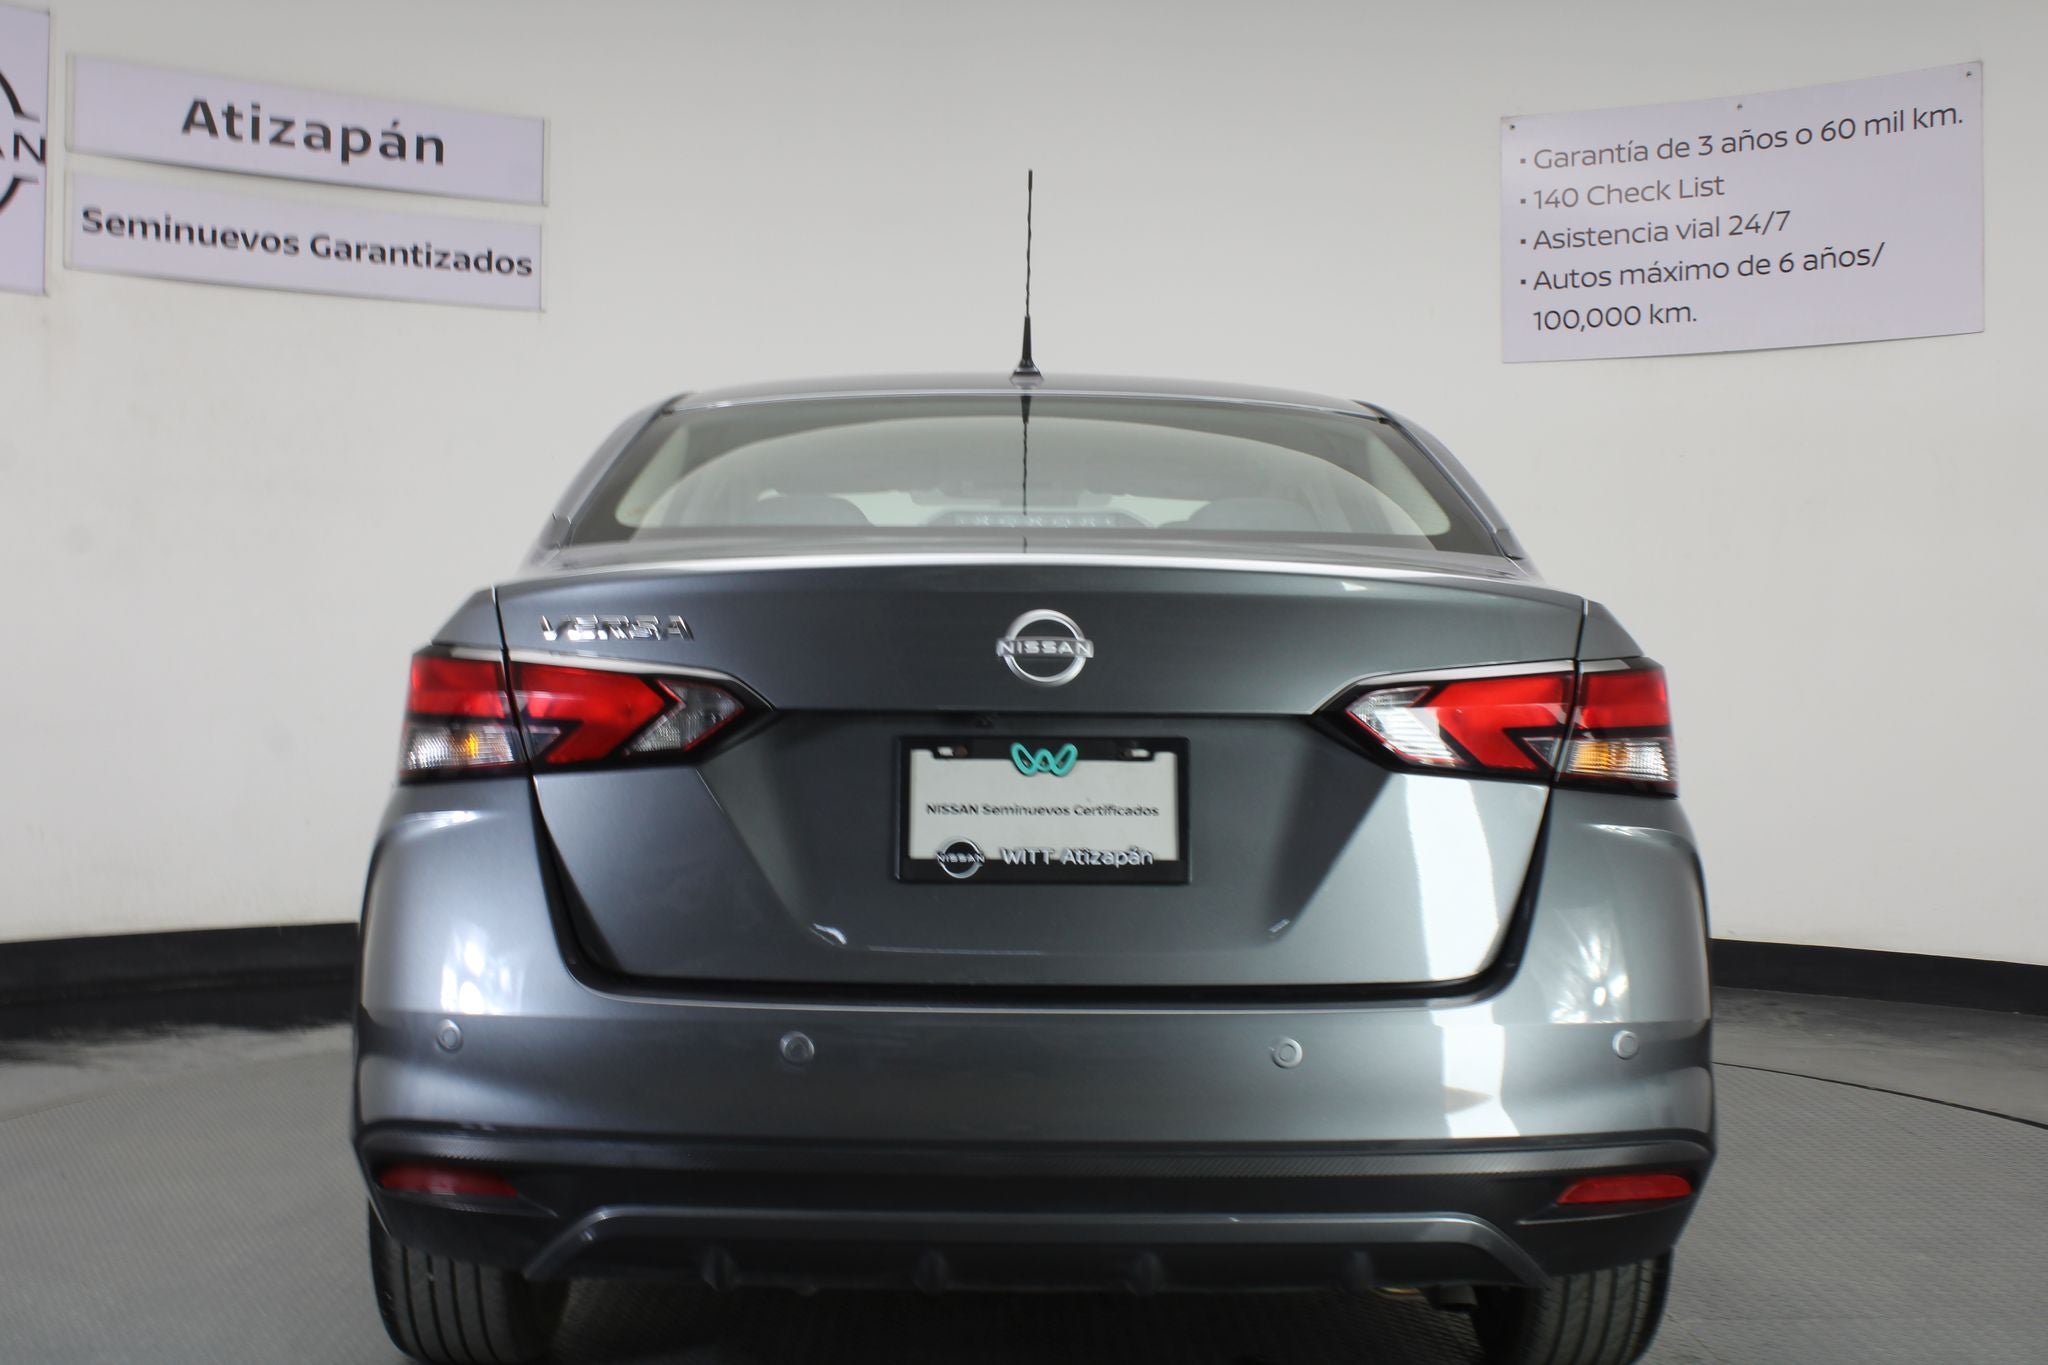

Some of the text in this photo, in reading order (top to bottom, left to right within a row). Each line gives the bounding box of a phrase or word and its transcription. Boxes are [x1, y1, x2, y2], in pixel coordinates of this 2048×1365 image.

[0, 131, 46, 164] N
[181, 98, 444, 165] Atizapán
[1533, 105, 1963, 170] Garantía de 3 años o 60 mil km.
[1533, 175, 1725, 209] 140 Check List
[82, 207, 533, 276] Seminuevos Garantizados
[1533, 210, 1791, 250] Asistencia vial 24/7
[1533, 242, 1885, 290] Autos máximo de 6 años/
[1533, 302, 1697, 332] 100,000 km.
[540, 614, 694, 641] VERSA
[997, 640, 1094, 657] NISSAN
[926, 803, 1159, 818] NISSAN Seminuevos Certificados
[937, 851, 985, 863] NISSAN
[1000, 846, 1153, 868] WITT Atizapán
